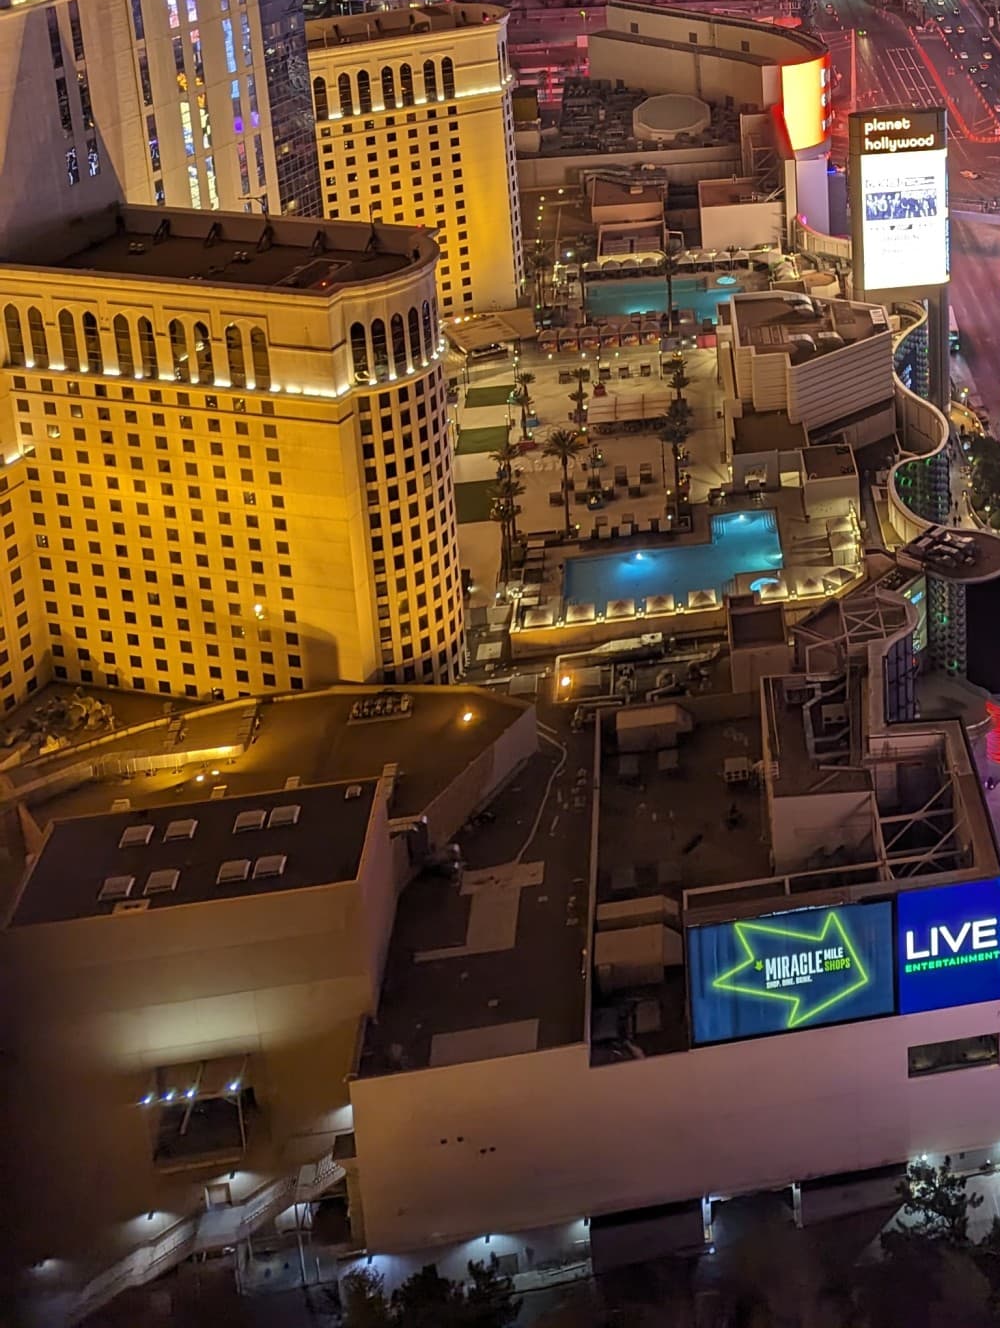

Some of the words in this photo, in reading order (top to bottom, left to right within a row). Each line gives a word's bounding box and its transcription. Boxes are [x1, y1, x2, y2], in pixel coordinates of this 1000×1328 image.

[863, 117, 911, 135] planet
[864, 134, 935, 152] hollywood
[905, 918, 999, 960] LIVE
[765, 950, 824, 981] MIRACLE
[823, 946, 844, 960] MILE
[824, 957, 851, 972] SHOPS
[904, 950, 1000, 973] ENTERTAINMENT
